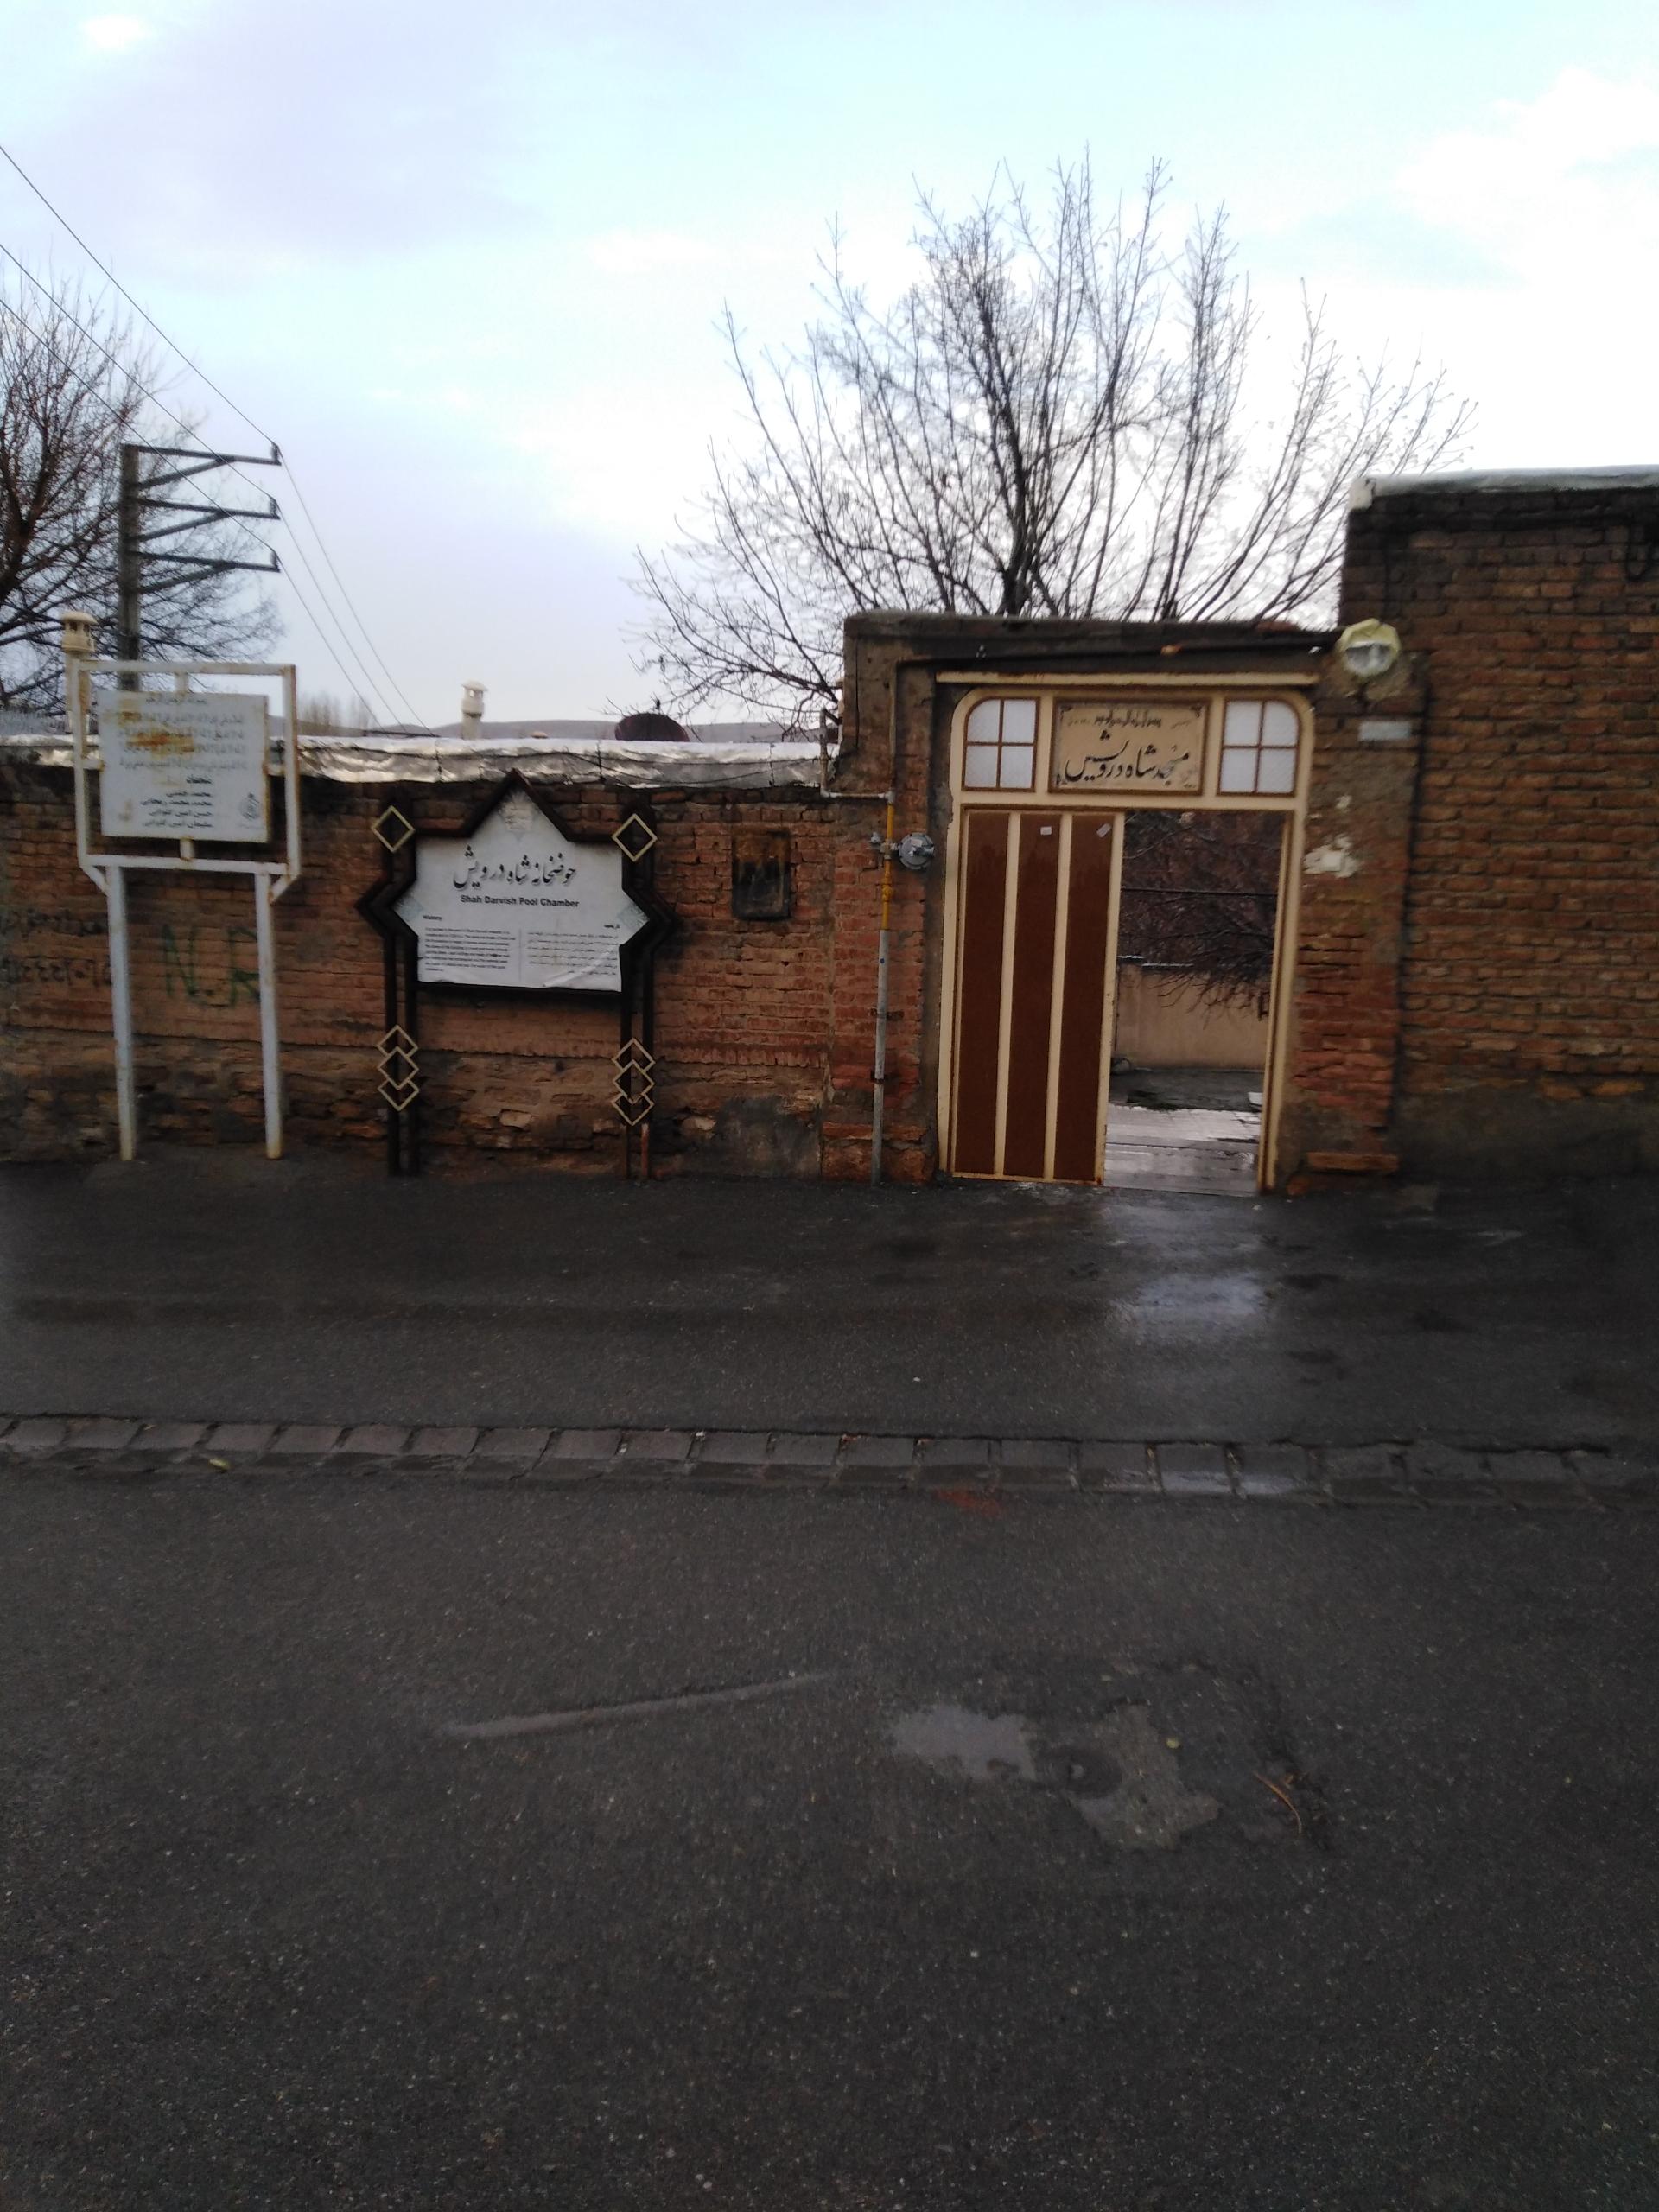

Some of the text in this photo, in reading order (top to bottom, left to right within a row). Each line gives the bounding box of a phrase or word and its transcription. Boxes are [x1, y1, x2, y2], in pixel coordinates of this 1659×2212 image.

[1065, 729, 1129, 781] درویش
[1125, 744, 1155, 778] شاه
[453, 844, 505, 889] درویش
[506, 854, 530, 885] شاه
[460, 893, 580, 907] Shah Darvish Pool Chamber
